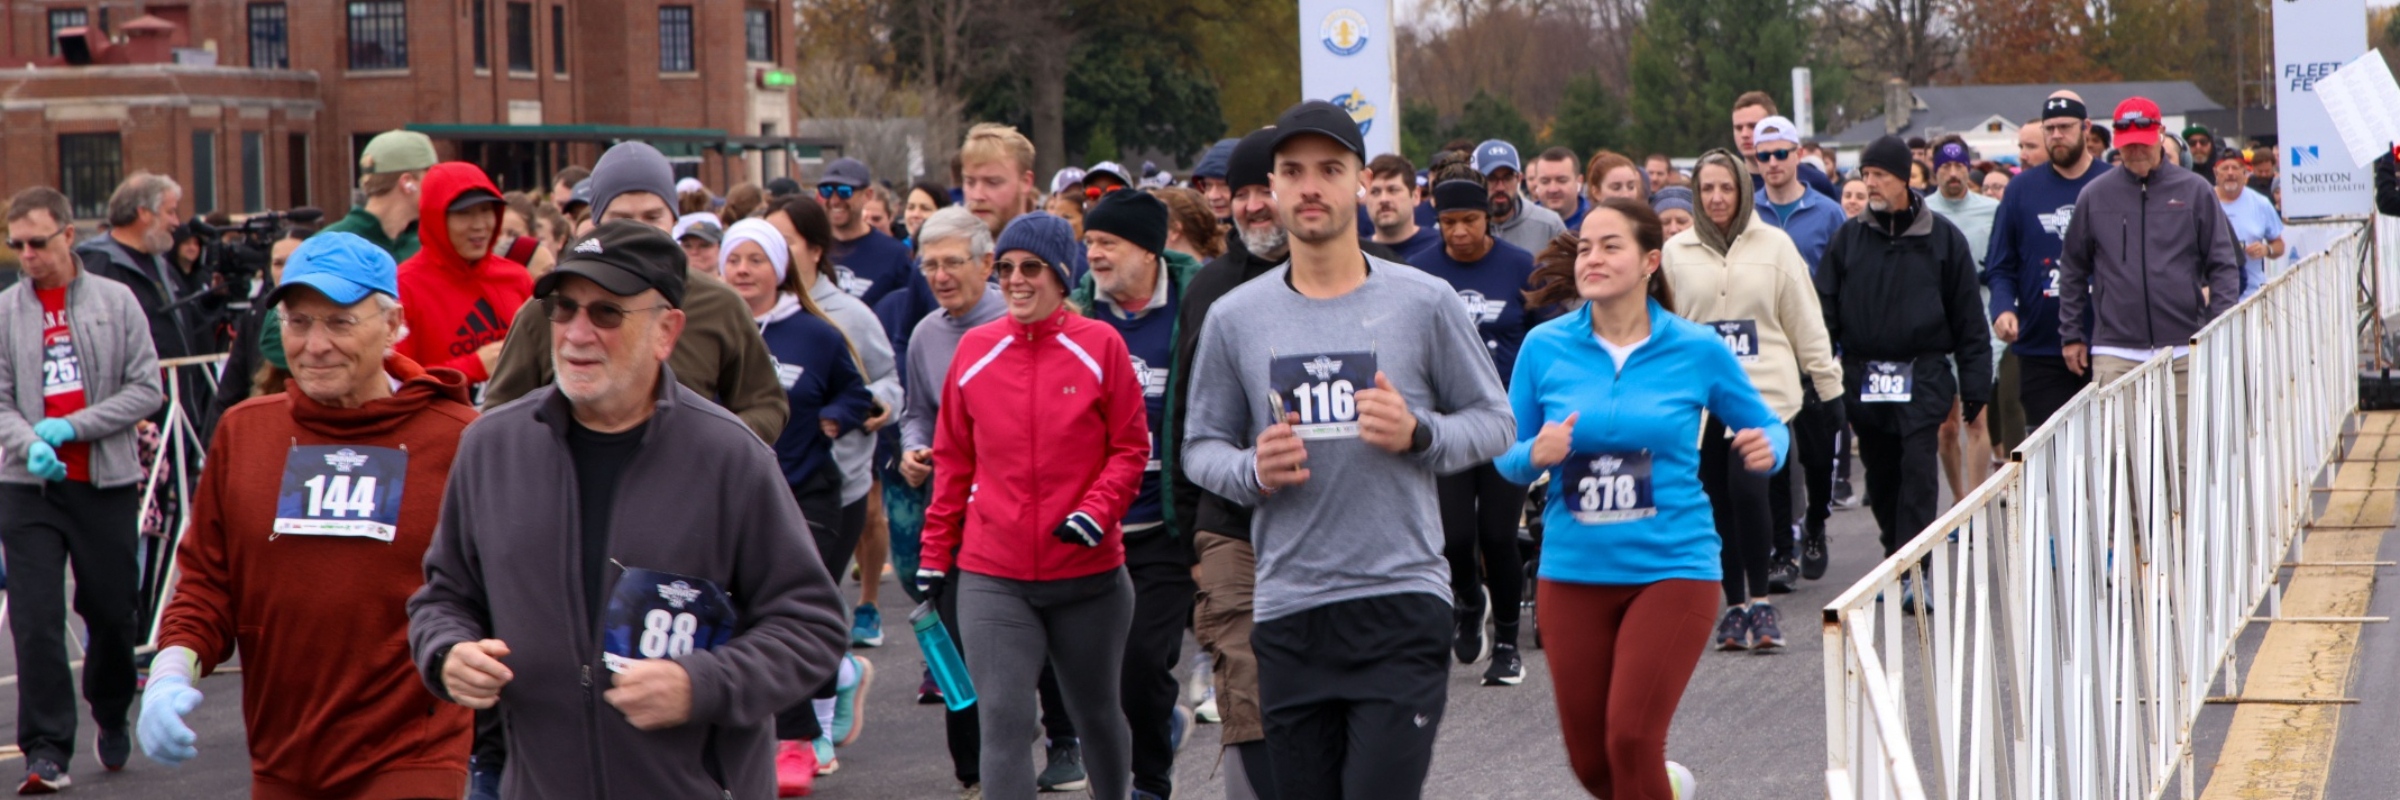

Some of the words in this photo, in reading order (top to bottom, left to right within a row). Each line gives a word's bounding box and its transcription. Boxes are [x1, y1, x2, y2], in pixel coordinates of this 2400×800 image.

[2285, 62, 2342, 78] FLEET
[2291, 77, 2325, 92] FE
[2291, 172, 2351, 184] NORTON
[2328, 182, 2365, 192] HEALTH
[1724, 334, 1750, 355] 04
[1868, 373, 1904, 394] 303
[1293, 379, 1356, 424] 116
[304, 474, 376, 517] 144
[1578, 474, 1637, 511] 378
[640, 608, 698, 661] 88
